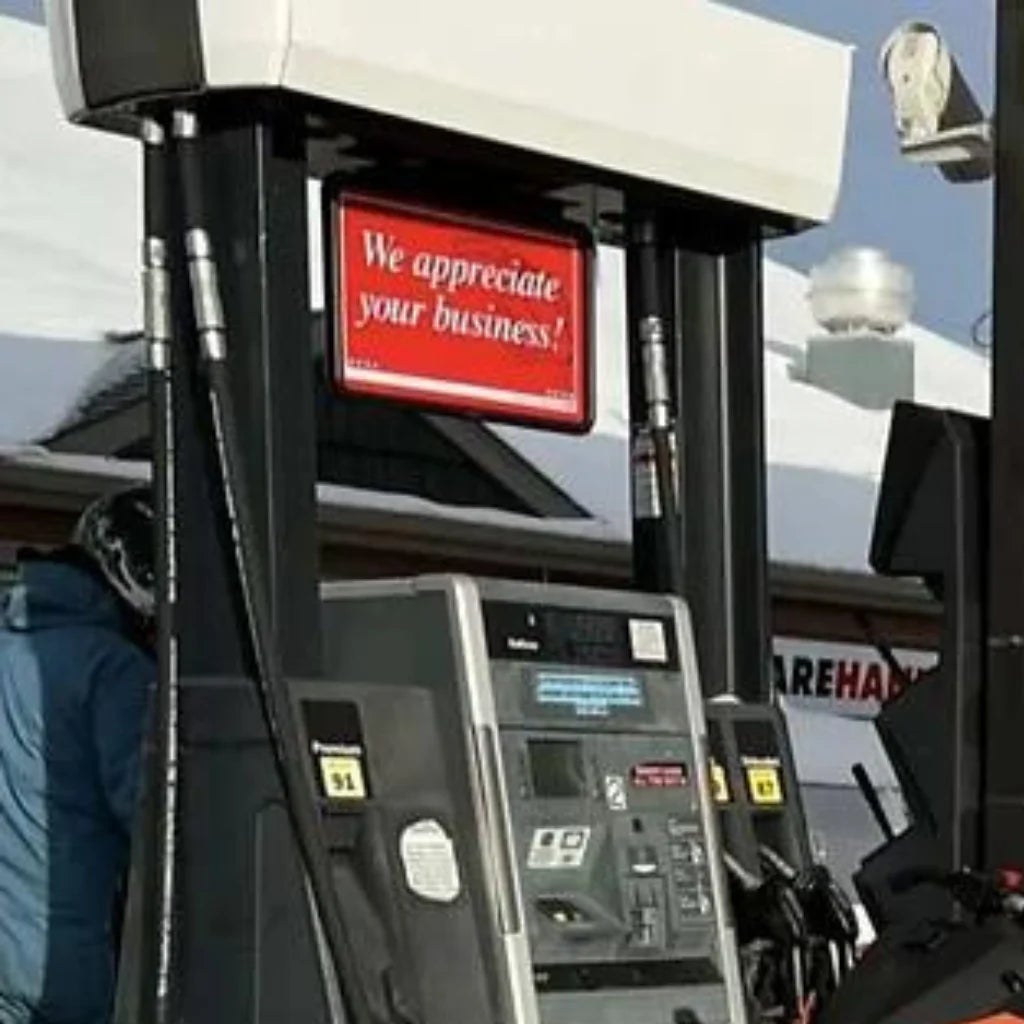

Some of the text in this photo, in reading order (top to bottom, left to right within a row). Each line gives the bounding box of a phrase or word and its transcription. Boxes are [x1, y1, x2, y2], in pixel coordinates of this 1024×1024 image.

[361, 229, 562, 302] We appreciate
[356, 292, 565, 353] your business!
